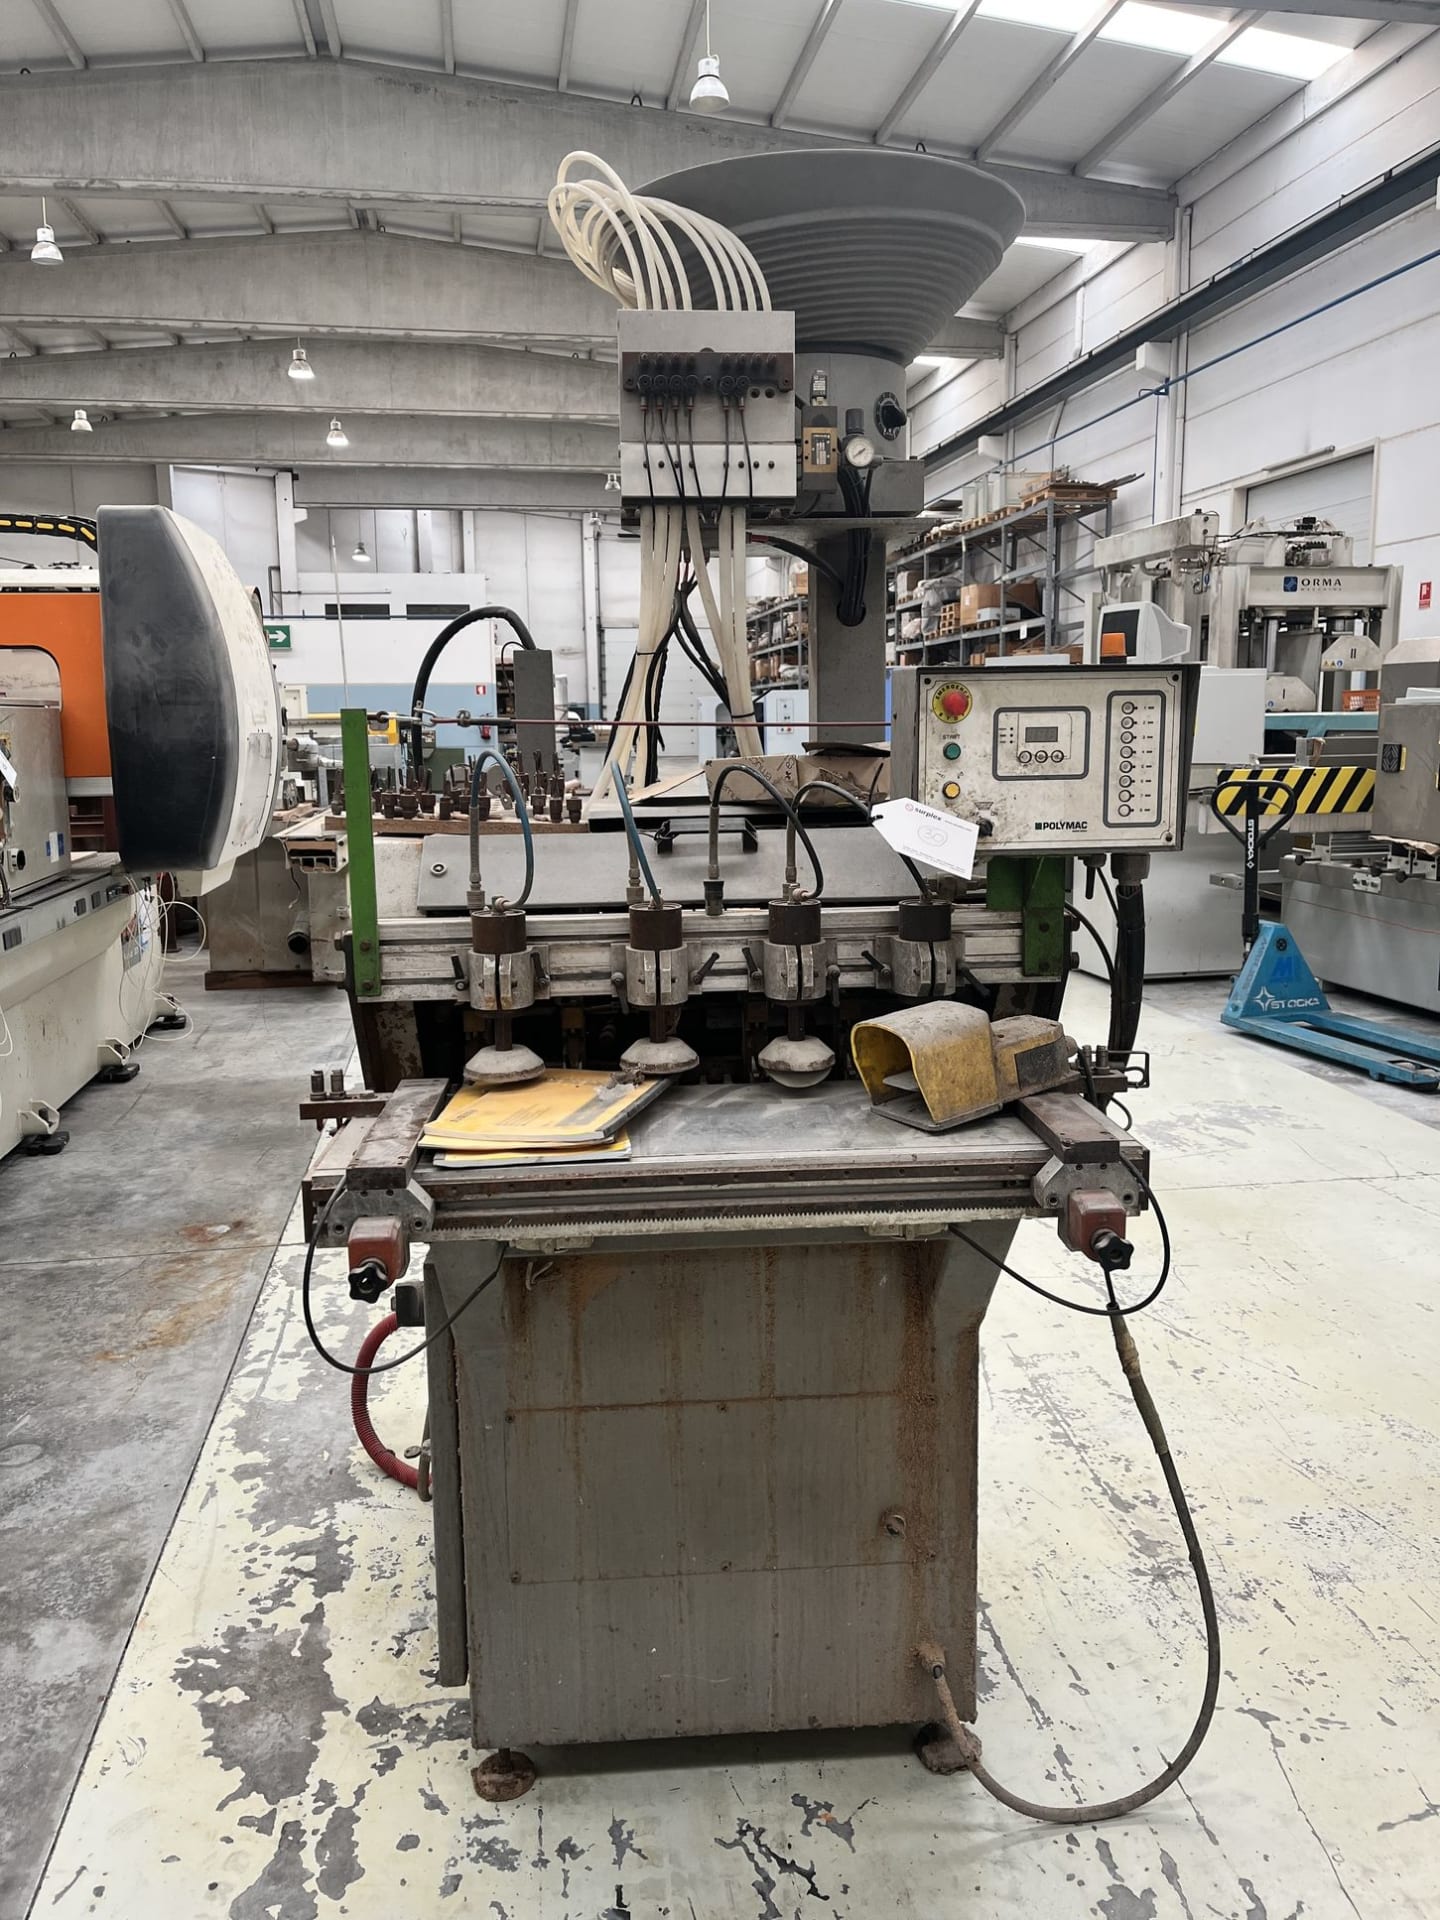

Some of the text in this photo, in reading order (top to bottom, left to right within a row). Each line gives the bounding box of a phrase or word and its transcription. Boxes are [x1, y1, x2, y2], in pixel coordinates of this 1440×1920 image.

[1301, 578, 1342, 587] ORMA
[1042, 821, 1088, 830] POLYMAC
[1270, 998, 1320, 1009] STOCKA
